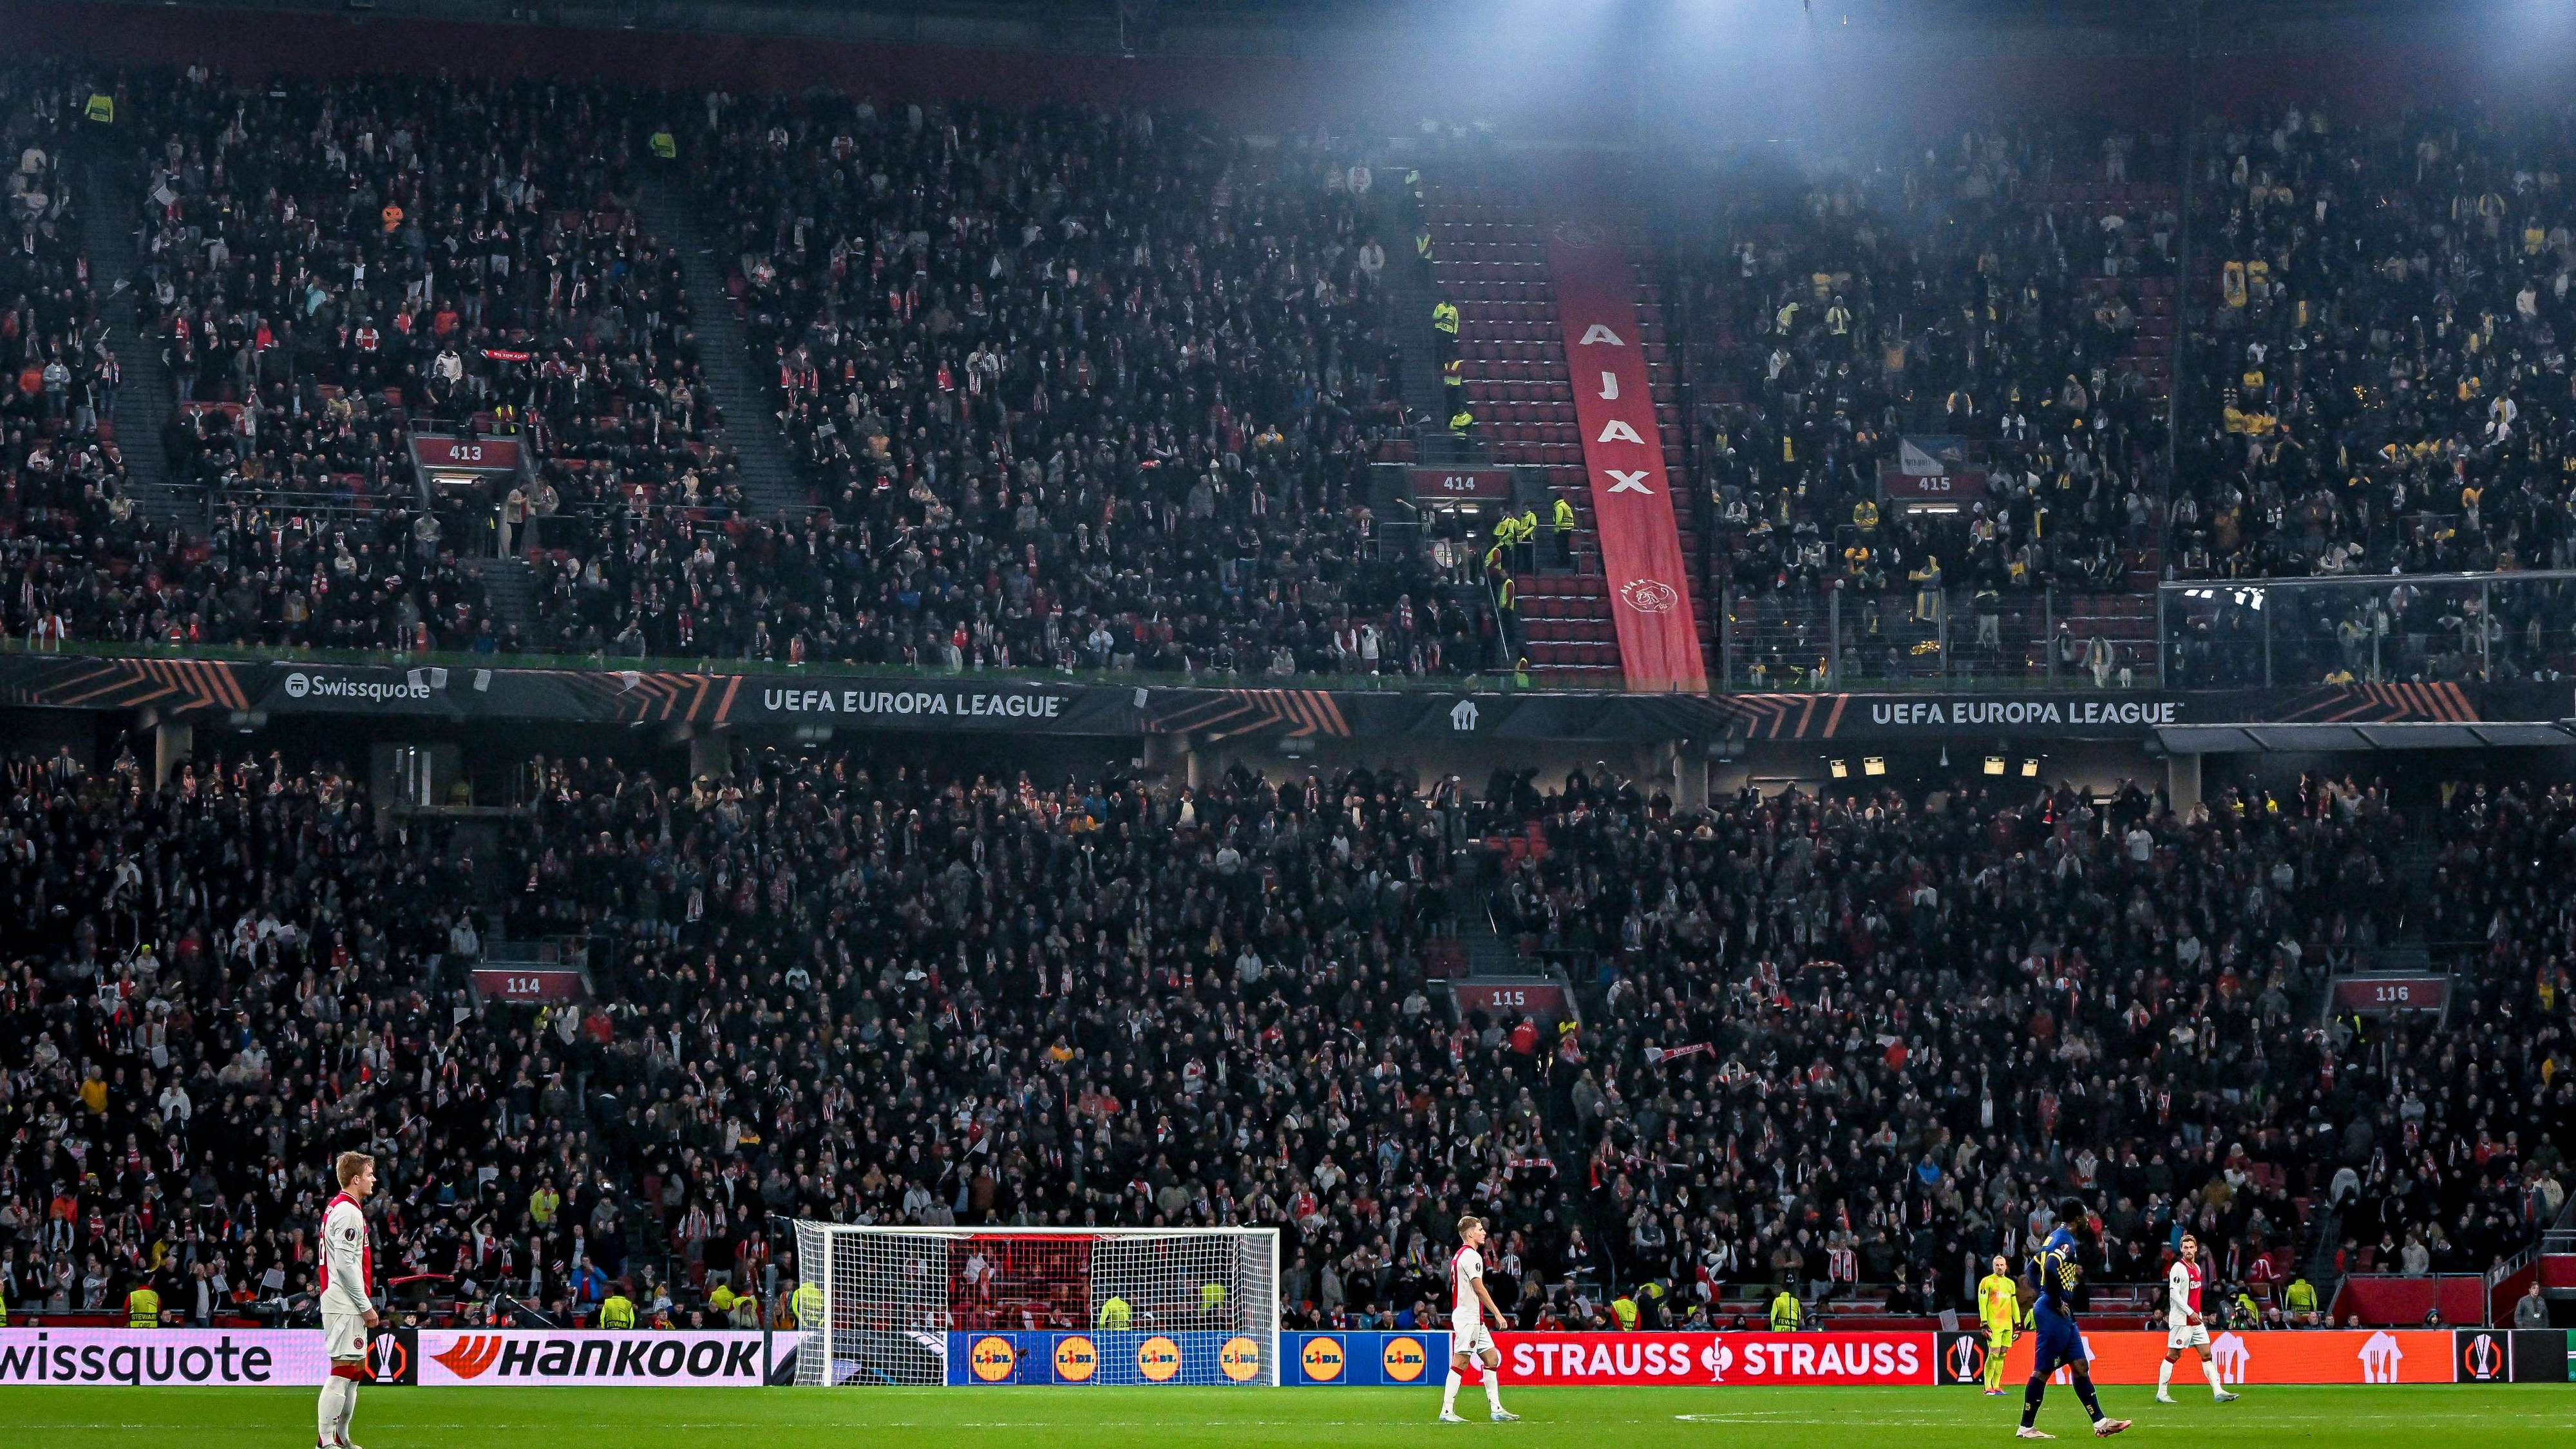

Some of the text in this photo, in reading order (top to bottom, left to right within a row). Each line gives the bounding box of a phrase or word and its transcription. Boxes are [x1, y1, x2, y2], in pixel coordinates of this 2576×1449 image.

[1578, 324, 1655, 495] AJAX
[450, 446, 482, 460] 413
[1444, 477, 1475, 490] 414
[1918, 477, 1951, 491] 415
[1620, 578, 1646, 595] AJAX
[312, 676, 430, 702] Swissquote
[764, 689, 836, 712] UEFA
[844, 690, 948, 715] EUROPA
[1872, 703, 1945, 725] UEFA
[1953, 702, 2058, 725] EUROPA
[507, 978, 540, 993] 114
[2376, 987, 2409, 1001] 116
[1493, 991, 1524, 1006] 115
[0, 1332, 271, 1386] wissquote
[1512, 1341, 1918, 1376] STRAUSS STRAUSS
